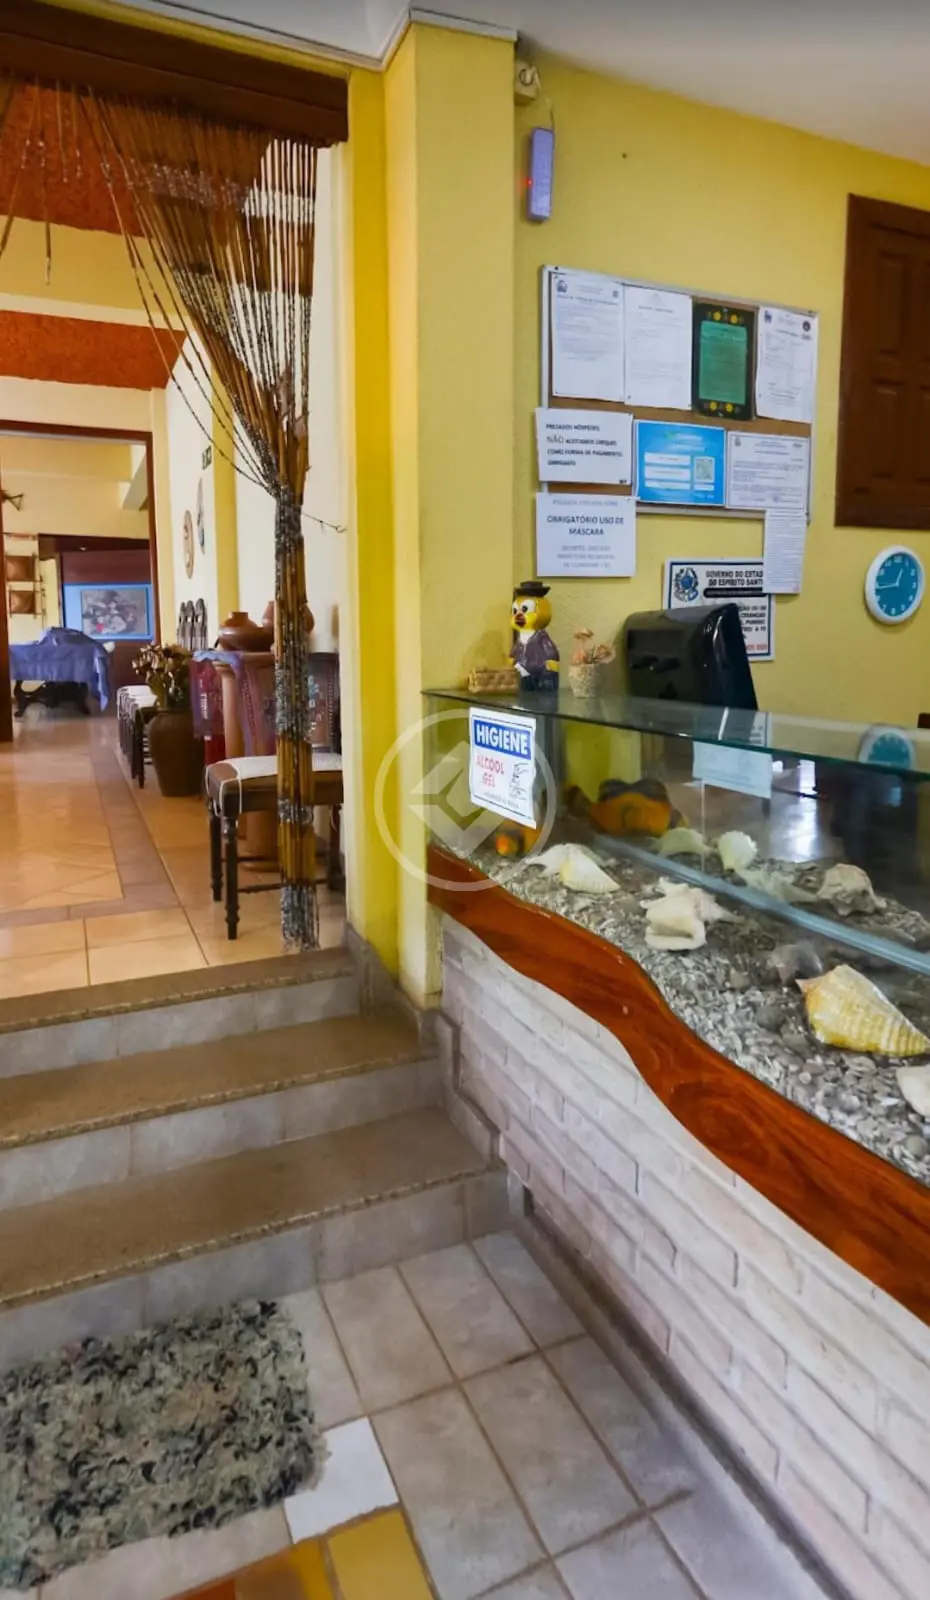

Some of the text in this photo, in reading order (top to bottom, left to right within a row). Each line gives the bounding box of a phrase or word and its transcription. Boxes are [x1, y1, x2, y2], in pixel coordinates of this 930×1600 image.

[546, 434, 564, 443] NÃO
[547, 514, 624, 525] OBRIGATÓRIO USO DE
[568, 527, 604, 536] MÁSCARA
[476, 723, 528, 755] HIGIENE
[482, 772, 495, 788] GEL
